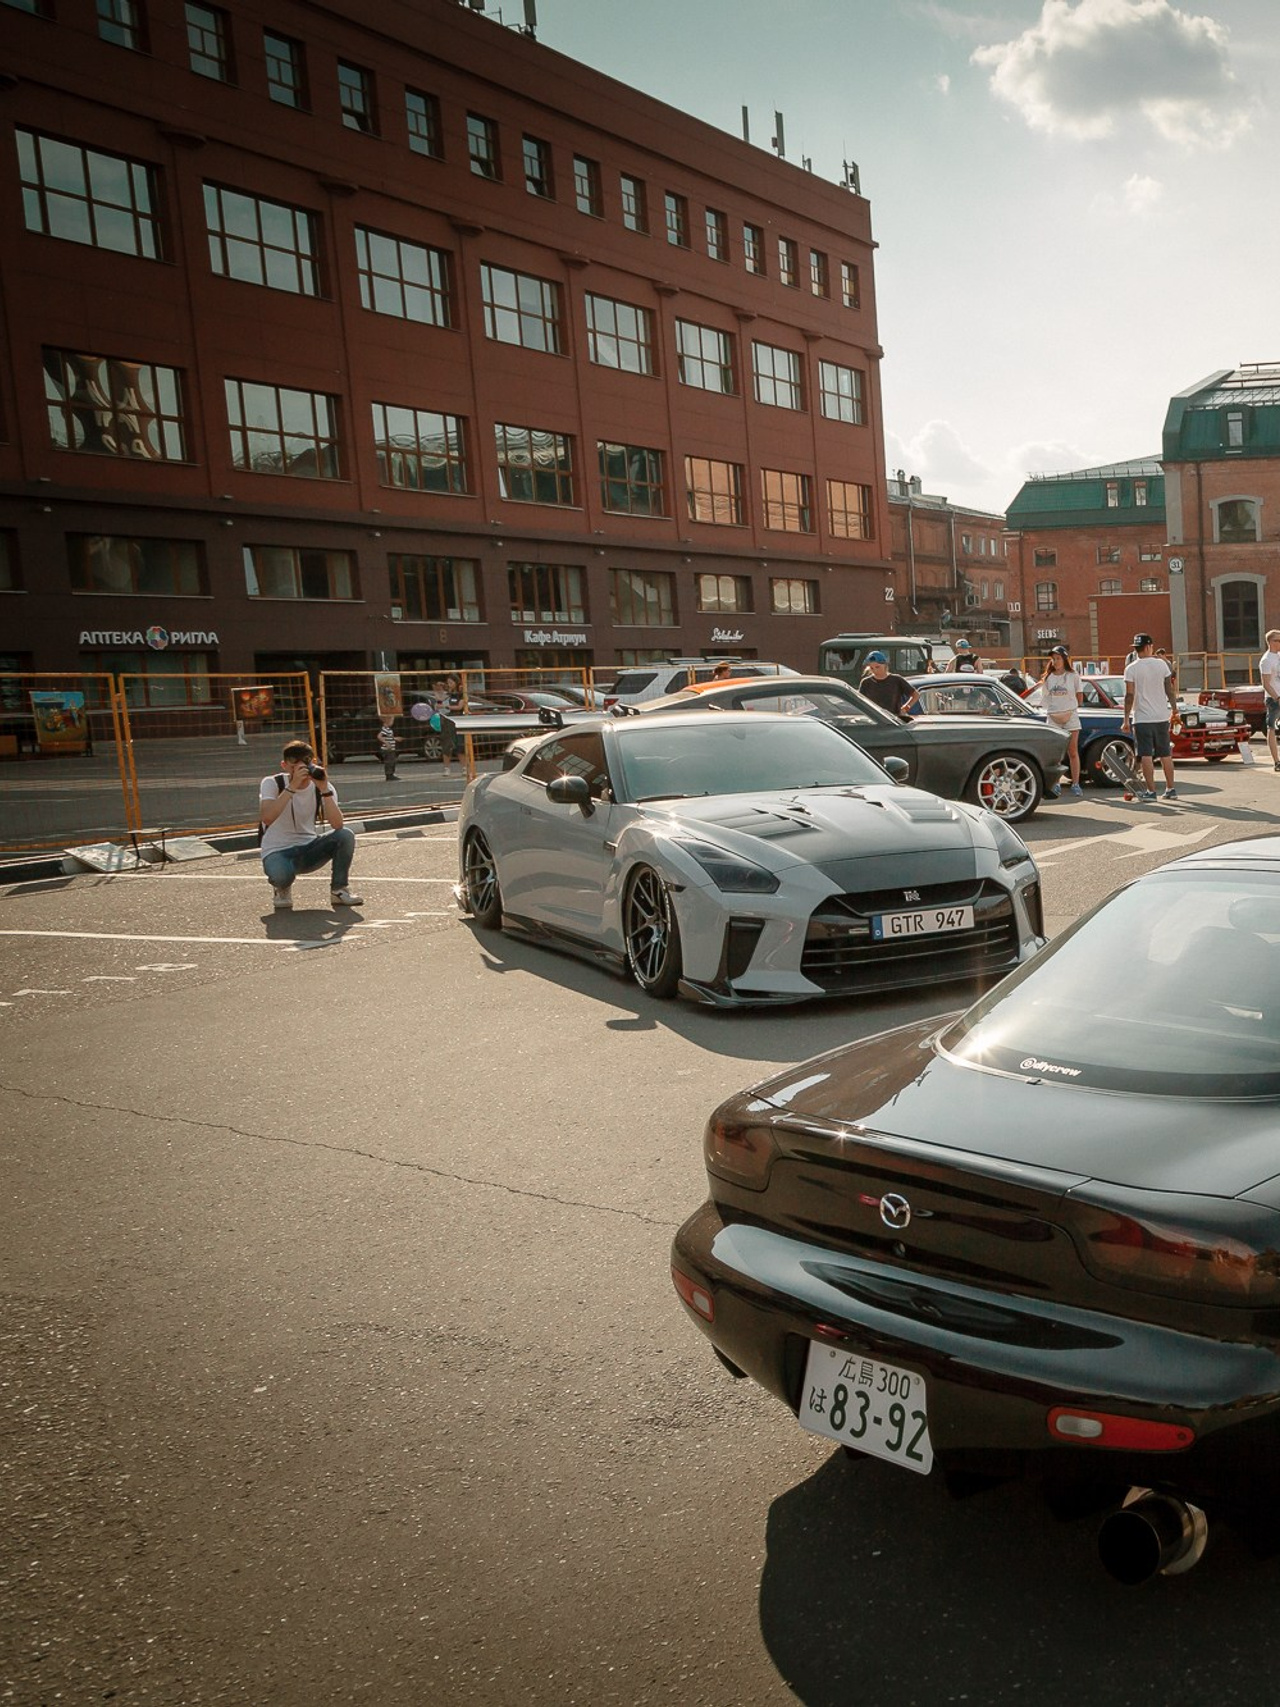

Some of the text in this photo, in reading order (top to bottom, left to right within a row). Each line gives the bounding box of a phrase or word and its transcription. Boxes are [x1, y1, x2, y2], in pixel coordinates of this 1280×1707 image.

[1170, 560, 1181, 569] 31
[885, 587, 895, 601] 22
[79, 631, 220, 645] АПТЕКА РИГЛА
[523, 630, 587, 647] Кафе Атриум
[891, 909, 965, 934] GTR 947
